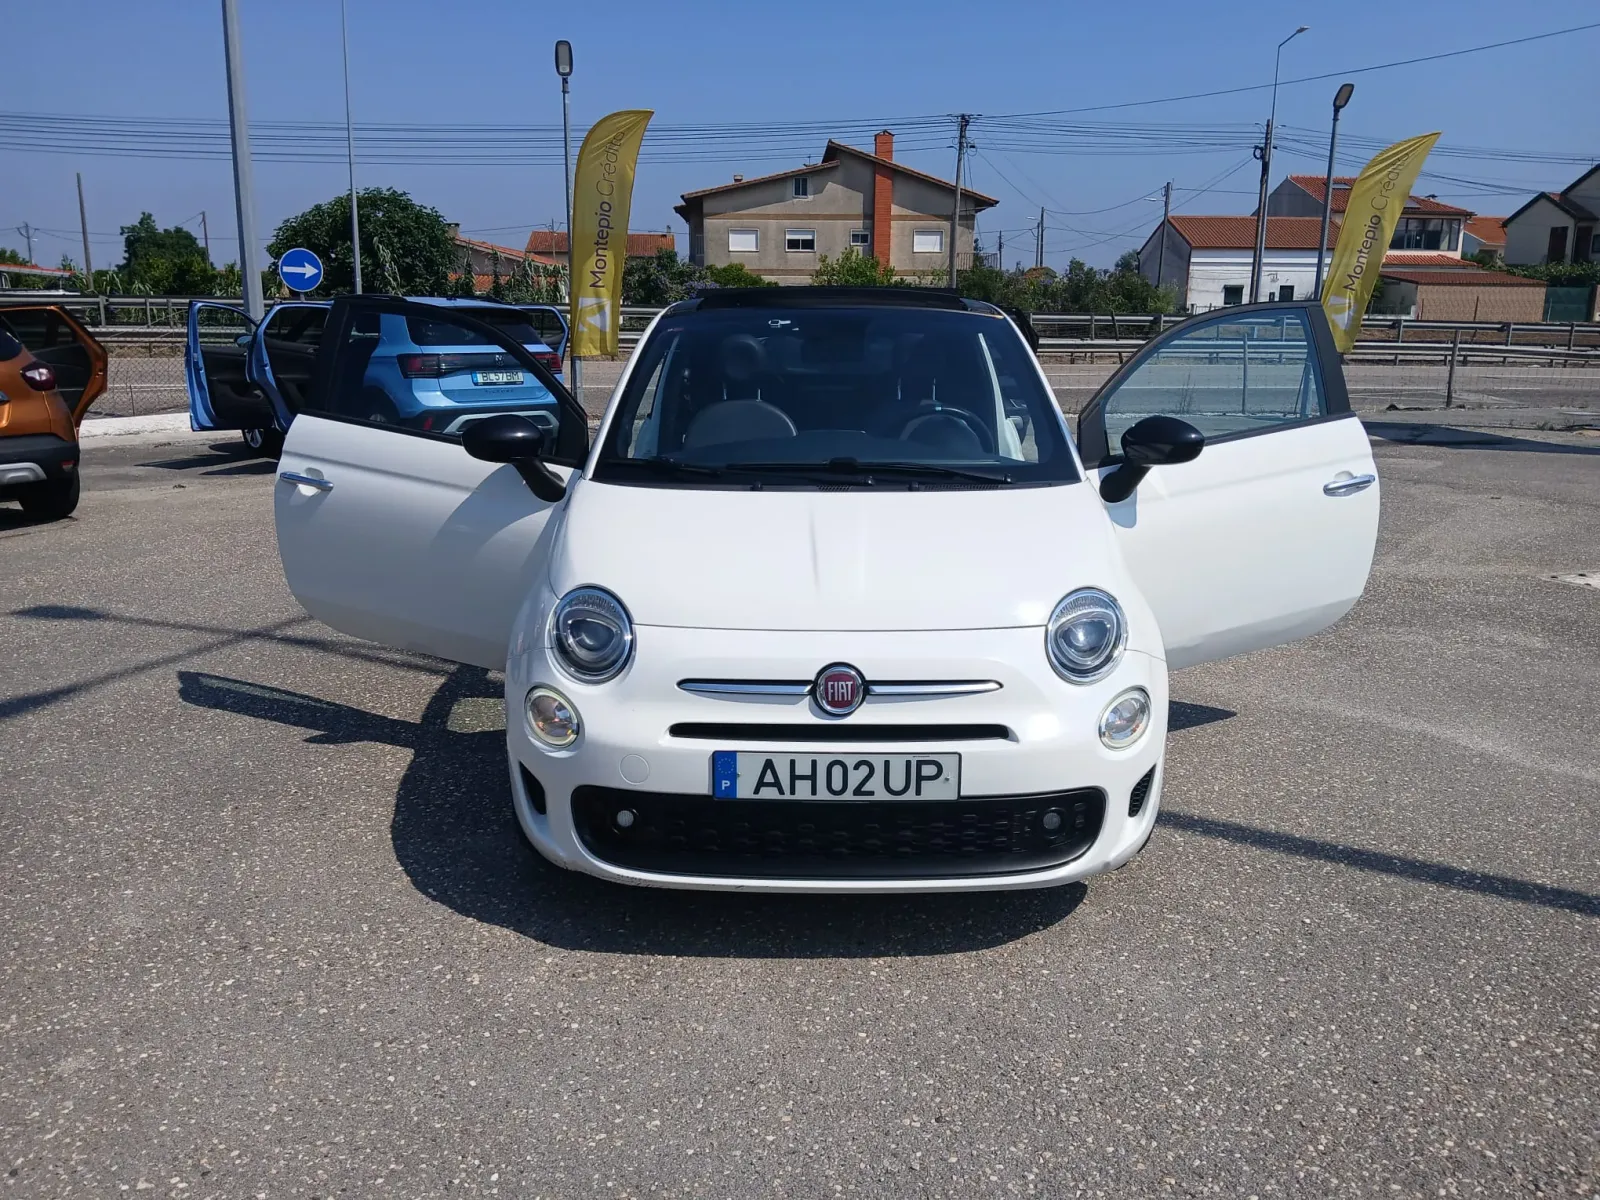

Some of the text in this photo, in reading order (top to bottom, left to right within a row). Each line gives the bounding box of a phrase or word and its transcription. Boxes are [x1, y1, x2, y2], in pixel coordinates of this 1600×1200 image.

[590, 131, 625, 288] Montepio Crédito
[1343, 214, 1381, 291] Montepio
[828, 681, 853, 701] FIAT
[721, 780, 731, 790] P
